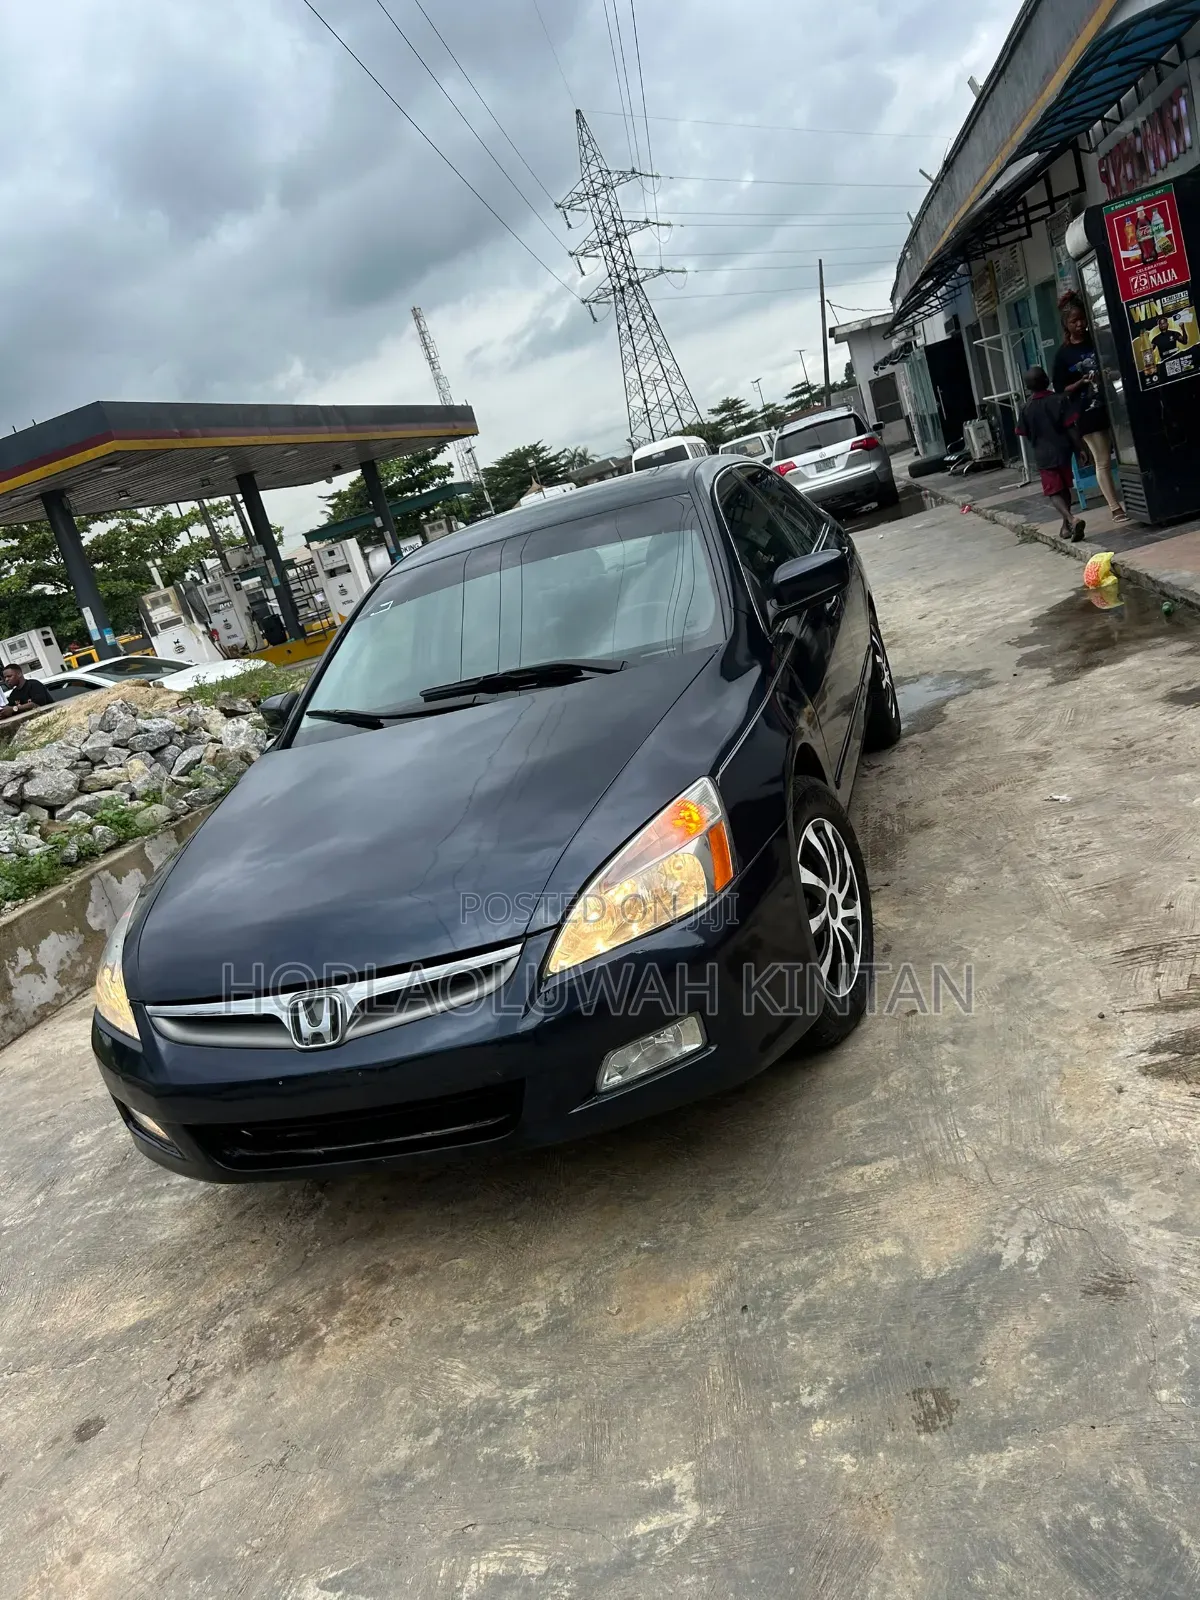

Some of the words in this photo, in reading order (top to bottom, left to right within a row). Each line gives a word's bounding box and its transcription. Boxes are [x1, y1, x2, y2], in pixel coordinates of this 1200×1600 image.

[1136, 260, 1168, 274] CELEBRATING
[1131, 273, 1148, 290] 75
[1150, 268, 1178, 288] NAIJA
[1134, 285, 1148, 293] YEARS
[1129, 299, 1163, 324] WIN
